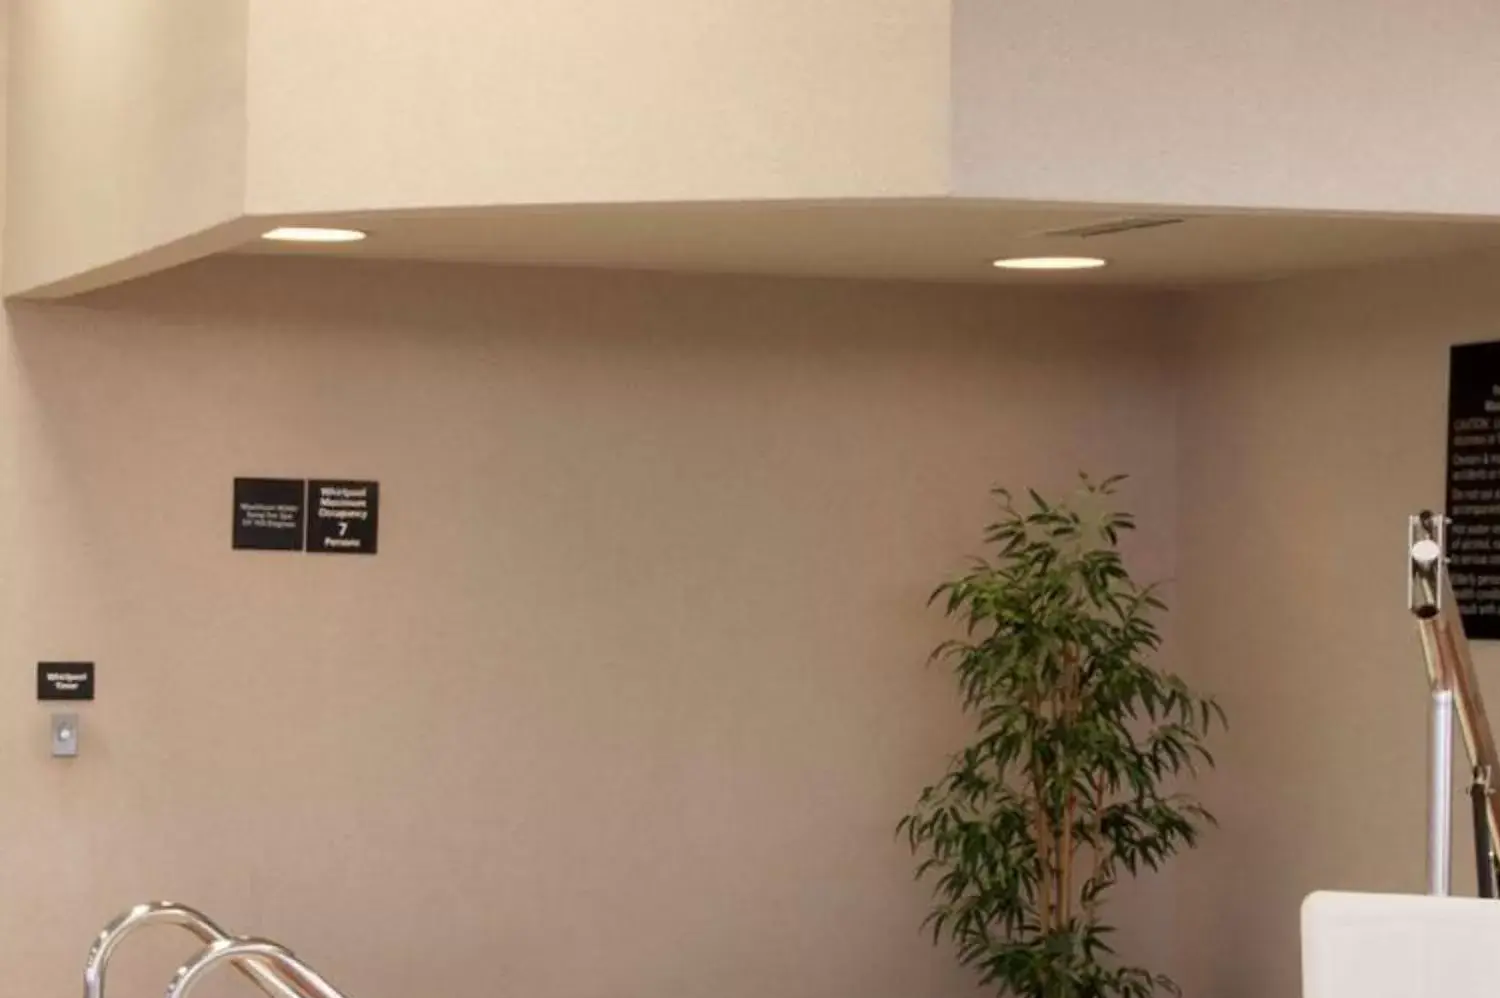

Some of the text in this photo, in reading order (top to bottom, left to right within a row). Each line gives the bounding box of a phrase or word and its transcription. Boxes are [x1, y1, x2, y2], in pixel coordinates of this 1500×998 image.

[320, 488, 366, 498] Whirlpool
[320, 498, 366, 507] Maximum
[318, 508, 368, 521] Occupancy
[337, 522, 348, 536] 7
[324, 537, 361, 548] Persons
[47, 672, 87, 682] Whirlpool
